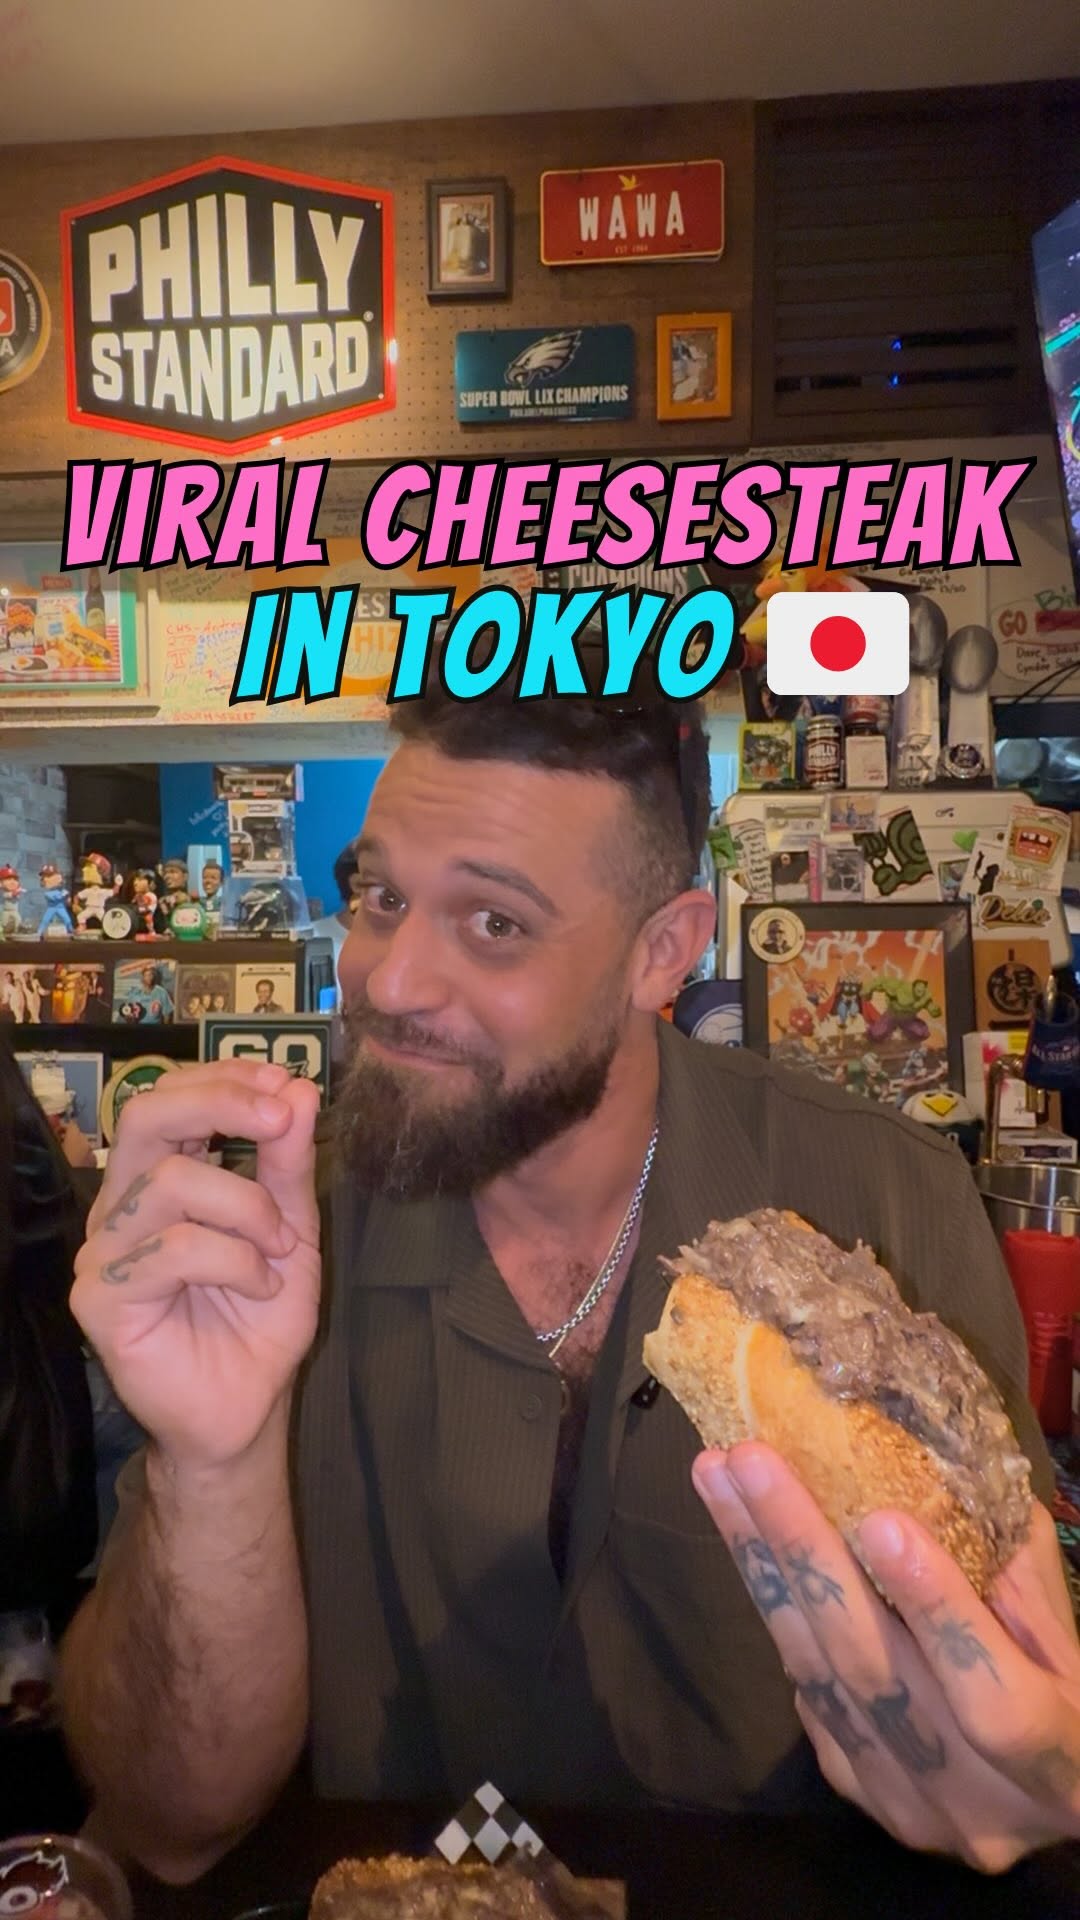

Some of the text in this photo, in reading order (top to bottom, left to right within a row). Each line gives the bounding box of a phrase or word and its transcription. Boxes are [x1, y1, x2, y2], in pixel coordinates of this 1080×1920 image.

[579, 190, 685, 241] WAWA
[88, 192, 364, 322] PHILLY
[91, 321, 369, 423] STANDARD
[459, 385, 629, 408] SUPER BOWL LIX CHAMPIONS
[998, 609, 1028, 637] GO
[980, 894, 1052, 922] Delco
